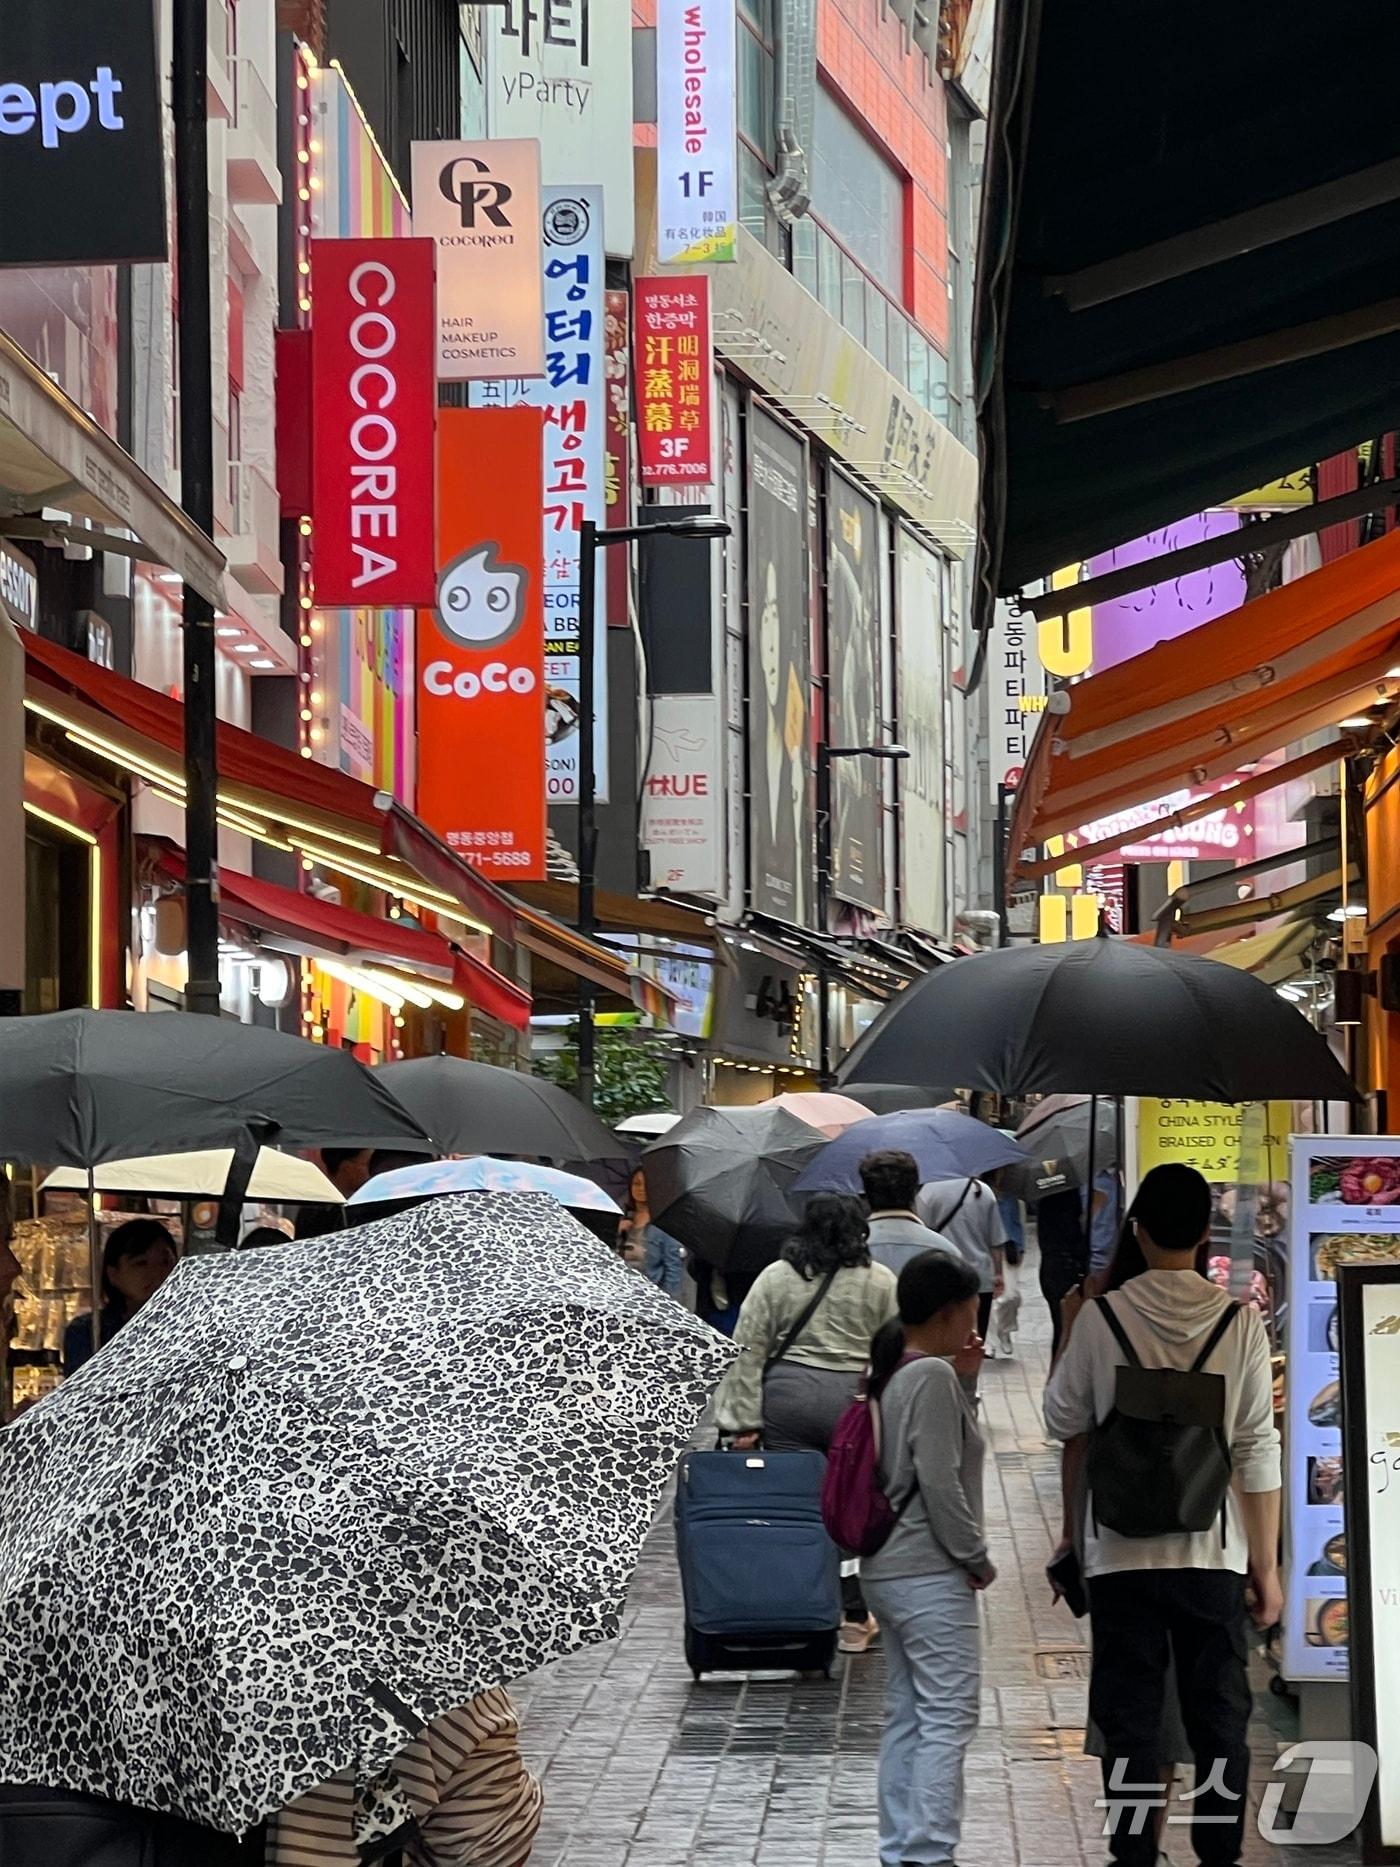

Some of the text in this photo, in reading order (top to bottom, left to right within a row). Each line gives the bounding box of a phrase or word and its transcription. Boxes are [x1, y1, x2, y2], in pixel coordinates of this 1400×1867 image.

[502, 72, 589, 114] yParty
[685, 6, 706, 153] wholesale
[0, 66, 124, 148] ept
[678, 170, 713, 197] 1F
[441, 317, 474, 328] HAIR
[544, 254, 592, 389] 엉터리
[645, 311, 698, 329] 한증막
[441, 331, 499, 343] MAKEUP
[441, 346, 517, 360] COSMETICS
[643, 335, 675, 433] 汗蒸幕
[677, 334, 700, 432] 明洞瑞草
[349, 261, 397, 589] COCOREA
[660, 437, 690, 457] 3F
[543, 400, 588, 533] 생고기
[668, 869, 685, 882] 2F
[1158, 1115, 1243, 1128] CHINA STYLE
[1158, 1136, 1216, 1148] BRAISED
